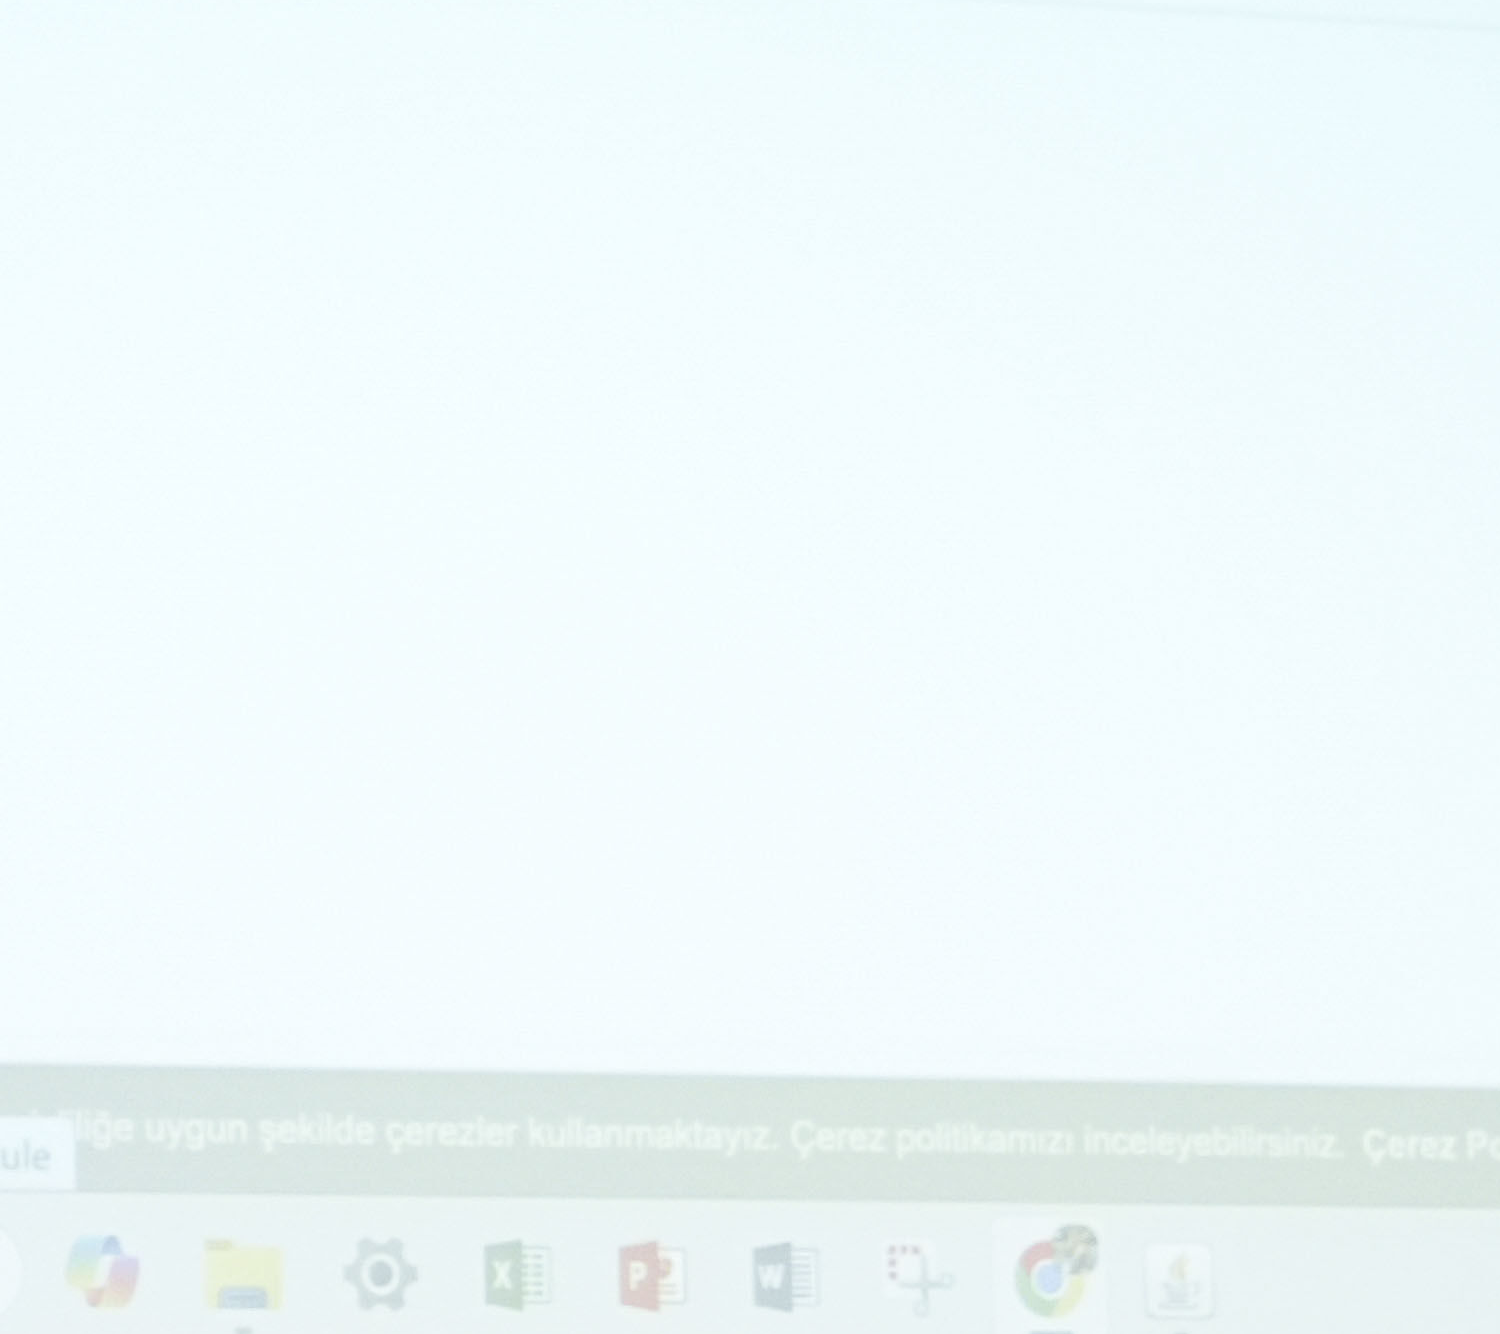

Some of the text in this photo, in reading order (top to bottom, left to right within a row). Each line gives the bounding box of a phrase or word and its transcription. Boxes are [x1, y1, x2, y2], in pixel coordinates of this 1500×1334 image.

[144, 1116, 249, 1151] uygun
[258, 1110, 376, 1154] şekilde
[386, 1115, 519, 1156] çerezler
[527, 1114, 781, 1159] kullanmaktayız.
[790, 1118, 886, 1161] Çerez
[895, 1121, 1076, 1164] politikamızı
[1083, 1124, 1347, 1167] inceleyebilirsiniz.
[1362, 1128, 1456, 1168] Çerez
